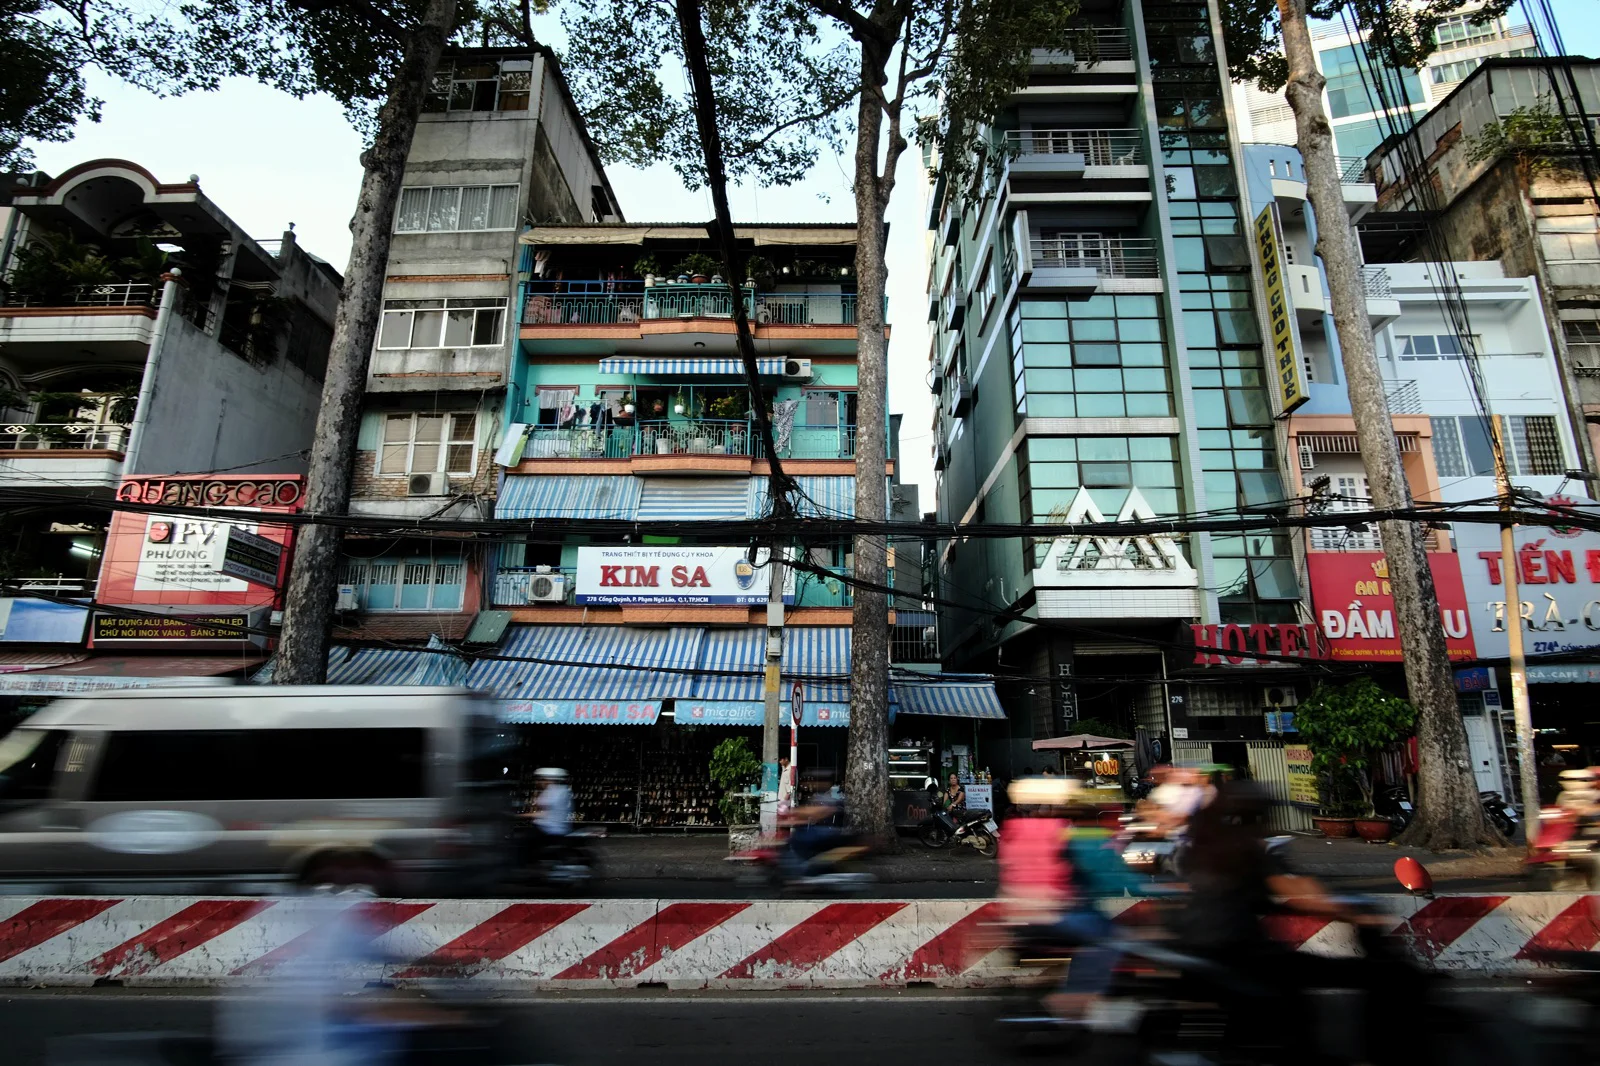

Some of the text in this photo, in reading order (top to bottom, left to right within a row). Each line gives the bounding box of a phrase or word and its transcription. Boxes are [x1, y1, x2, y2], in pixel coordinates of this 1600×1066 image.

[1270, 289, 1286, 336] CHO
[146, 549, 208, 560] PHƯƠNG
[599, 565, 711, 588] KIM SA
[1355, 580, 1379, 596] AN
[1322, 600, 1394, 639] ĐẦM
[1190, 624, 1331, 664] HOTEL
[575, 704, 655, 719] KIM SA
[705, 706, 756, 719] microlife
